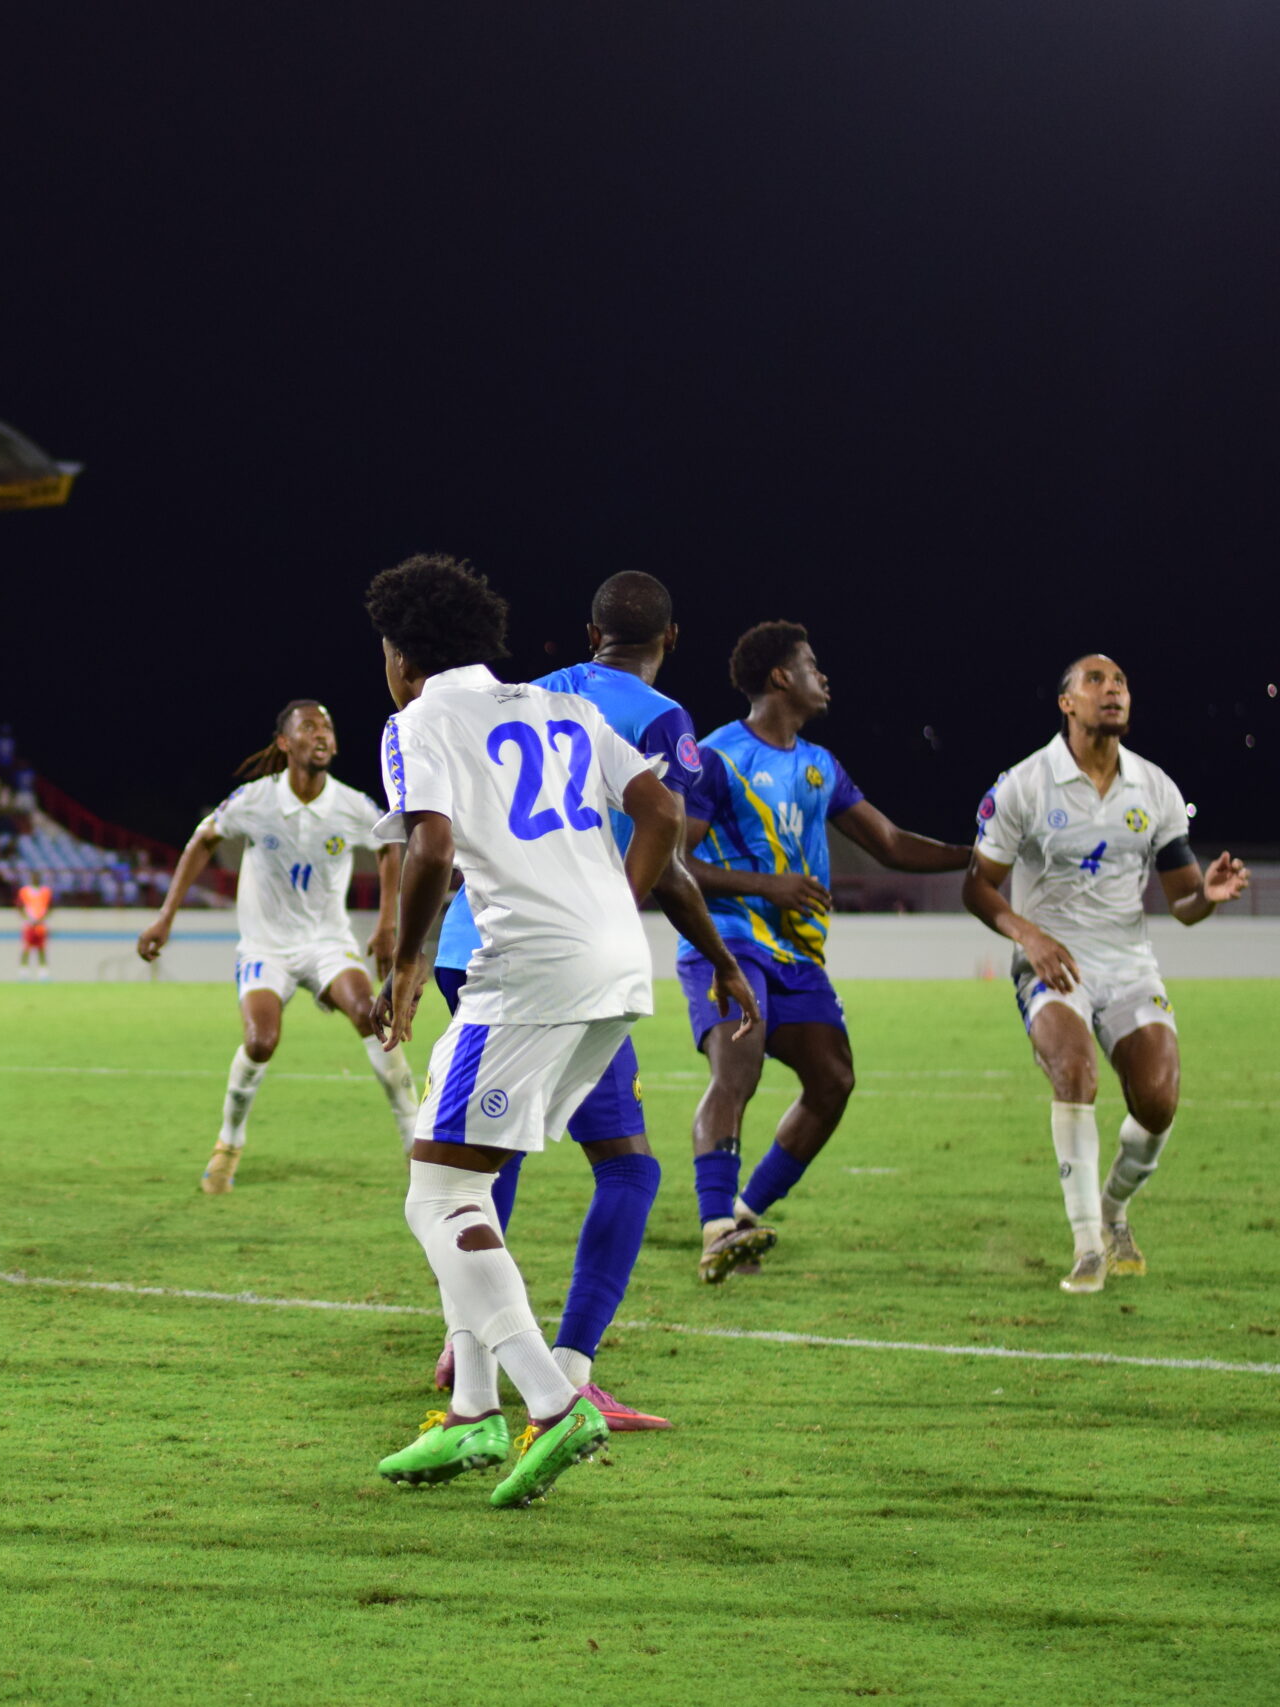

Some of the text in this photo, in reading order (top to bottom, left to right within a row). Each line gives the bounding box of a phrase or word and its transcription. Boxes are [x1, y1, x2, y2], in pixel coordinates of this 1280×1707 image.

[486, 719, 603, 841] 22
[1079, 840, 1108, 876] 4
[290, 863, 312, 891] 11
